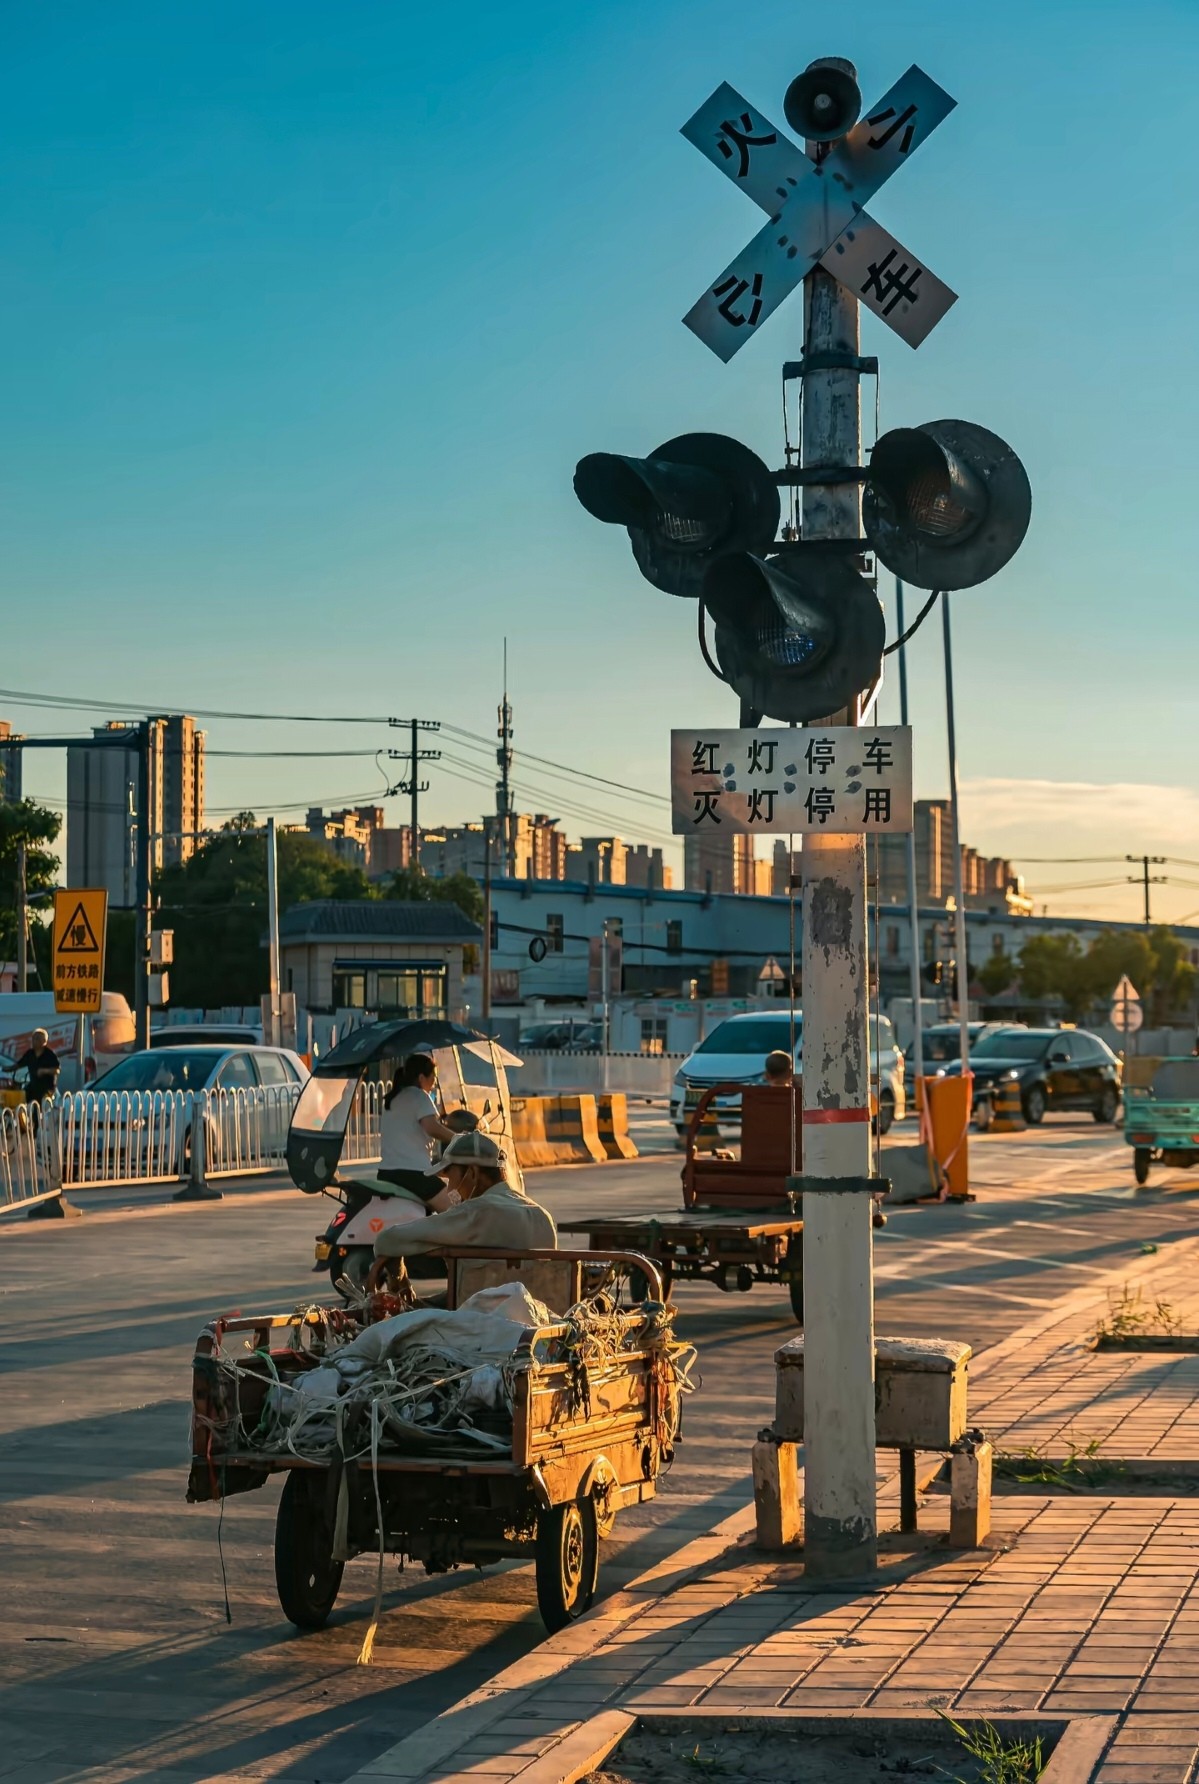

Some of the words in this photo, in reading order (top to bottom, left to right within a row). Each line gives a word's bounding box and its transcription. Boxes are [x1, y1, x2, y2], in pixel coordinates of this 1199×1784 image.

[691, 738, 893, 775] 红灯停车
[693, 787, 891, 824] 灭灯停用
[56, 964, 99, 979] 前方铁路
